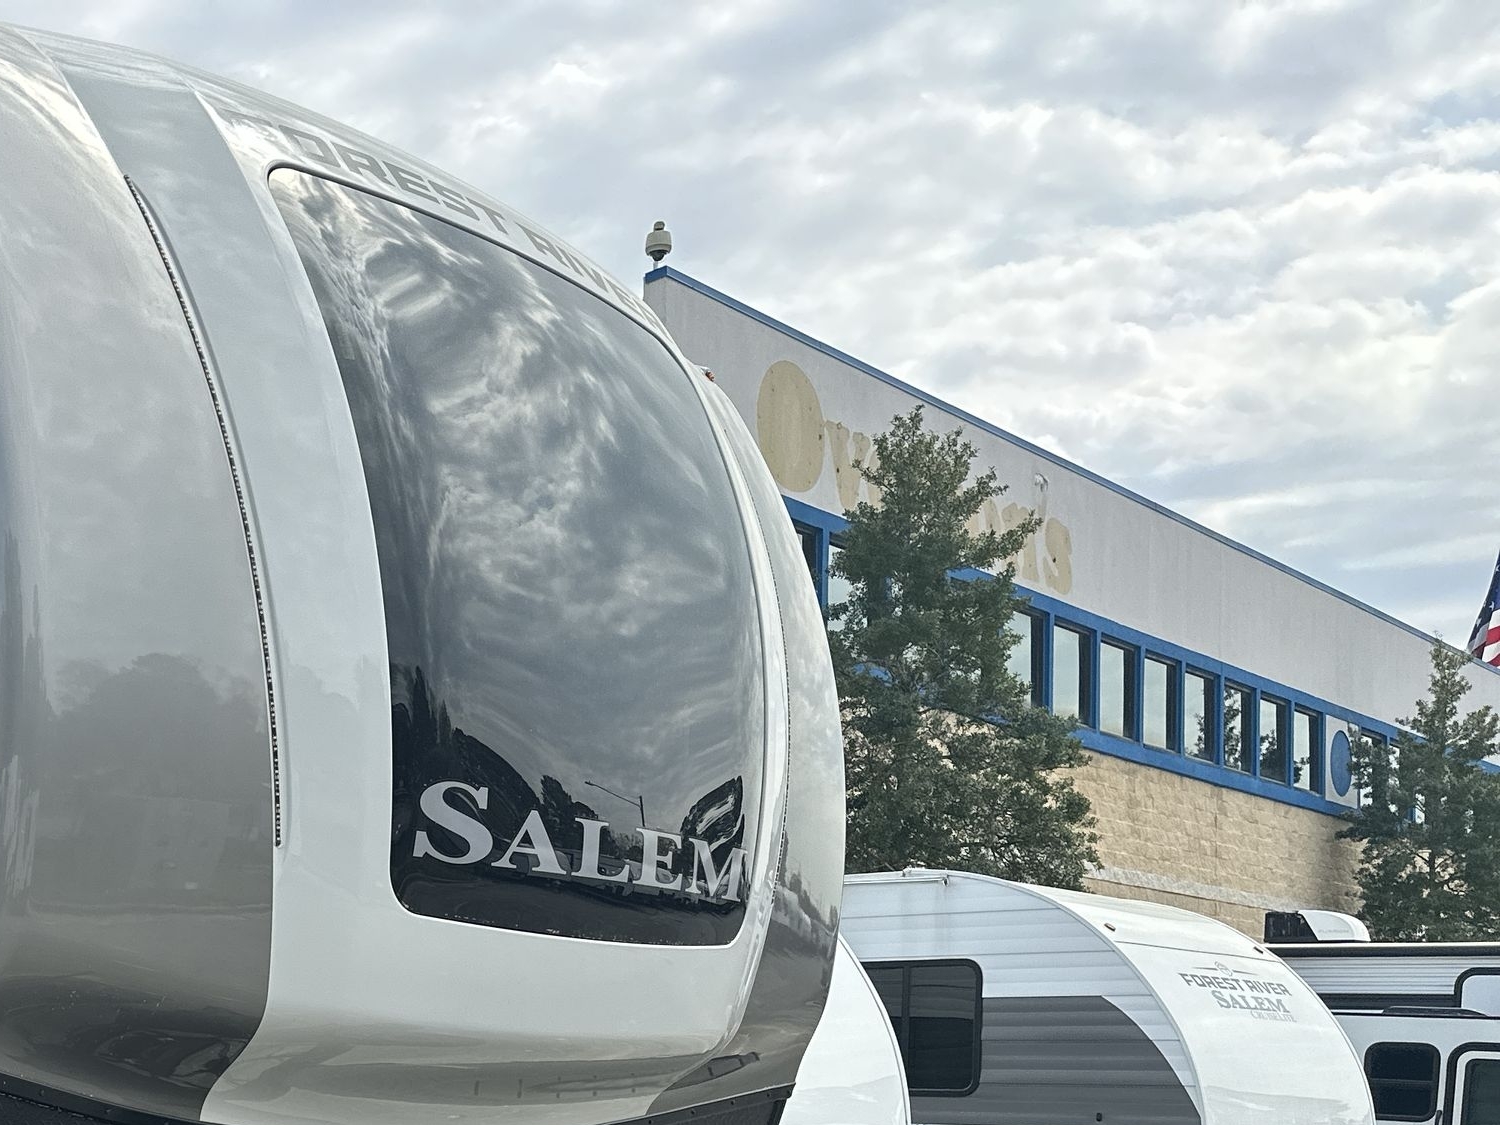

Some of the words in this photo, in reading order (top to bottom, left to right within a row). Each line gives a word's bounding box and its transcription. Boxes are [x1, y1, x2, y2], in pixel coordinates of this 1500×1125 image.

[515, 222, 674, 343] RIVER
[412, 780, 749, 903] SALEM
[1178, 972, 1244, 992] FOREST
[1242, 979, 1293, 996] RIVER
[1211, 989, 1292, 1014] SALEM
